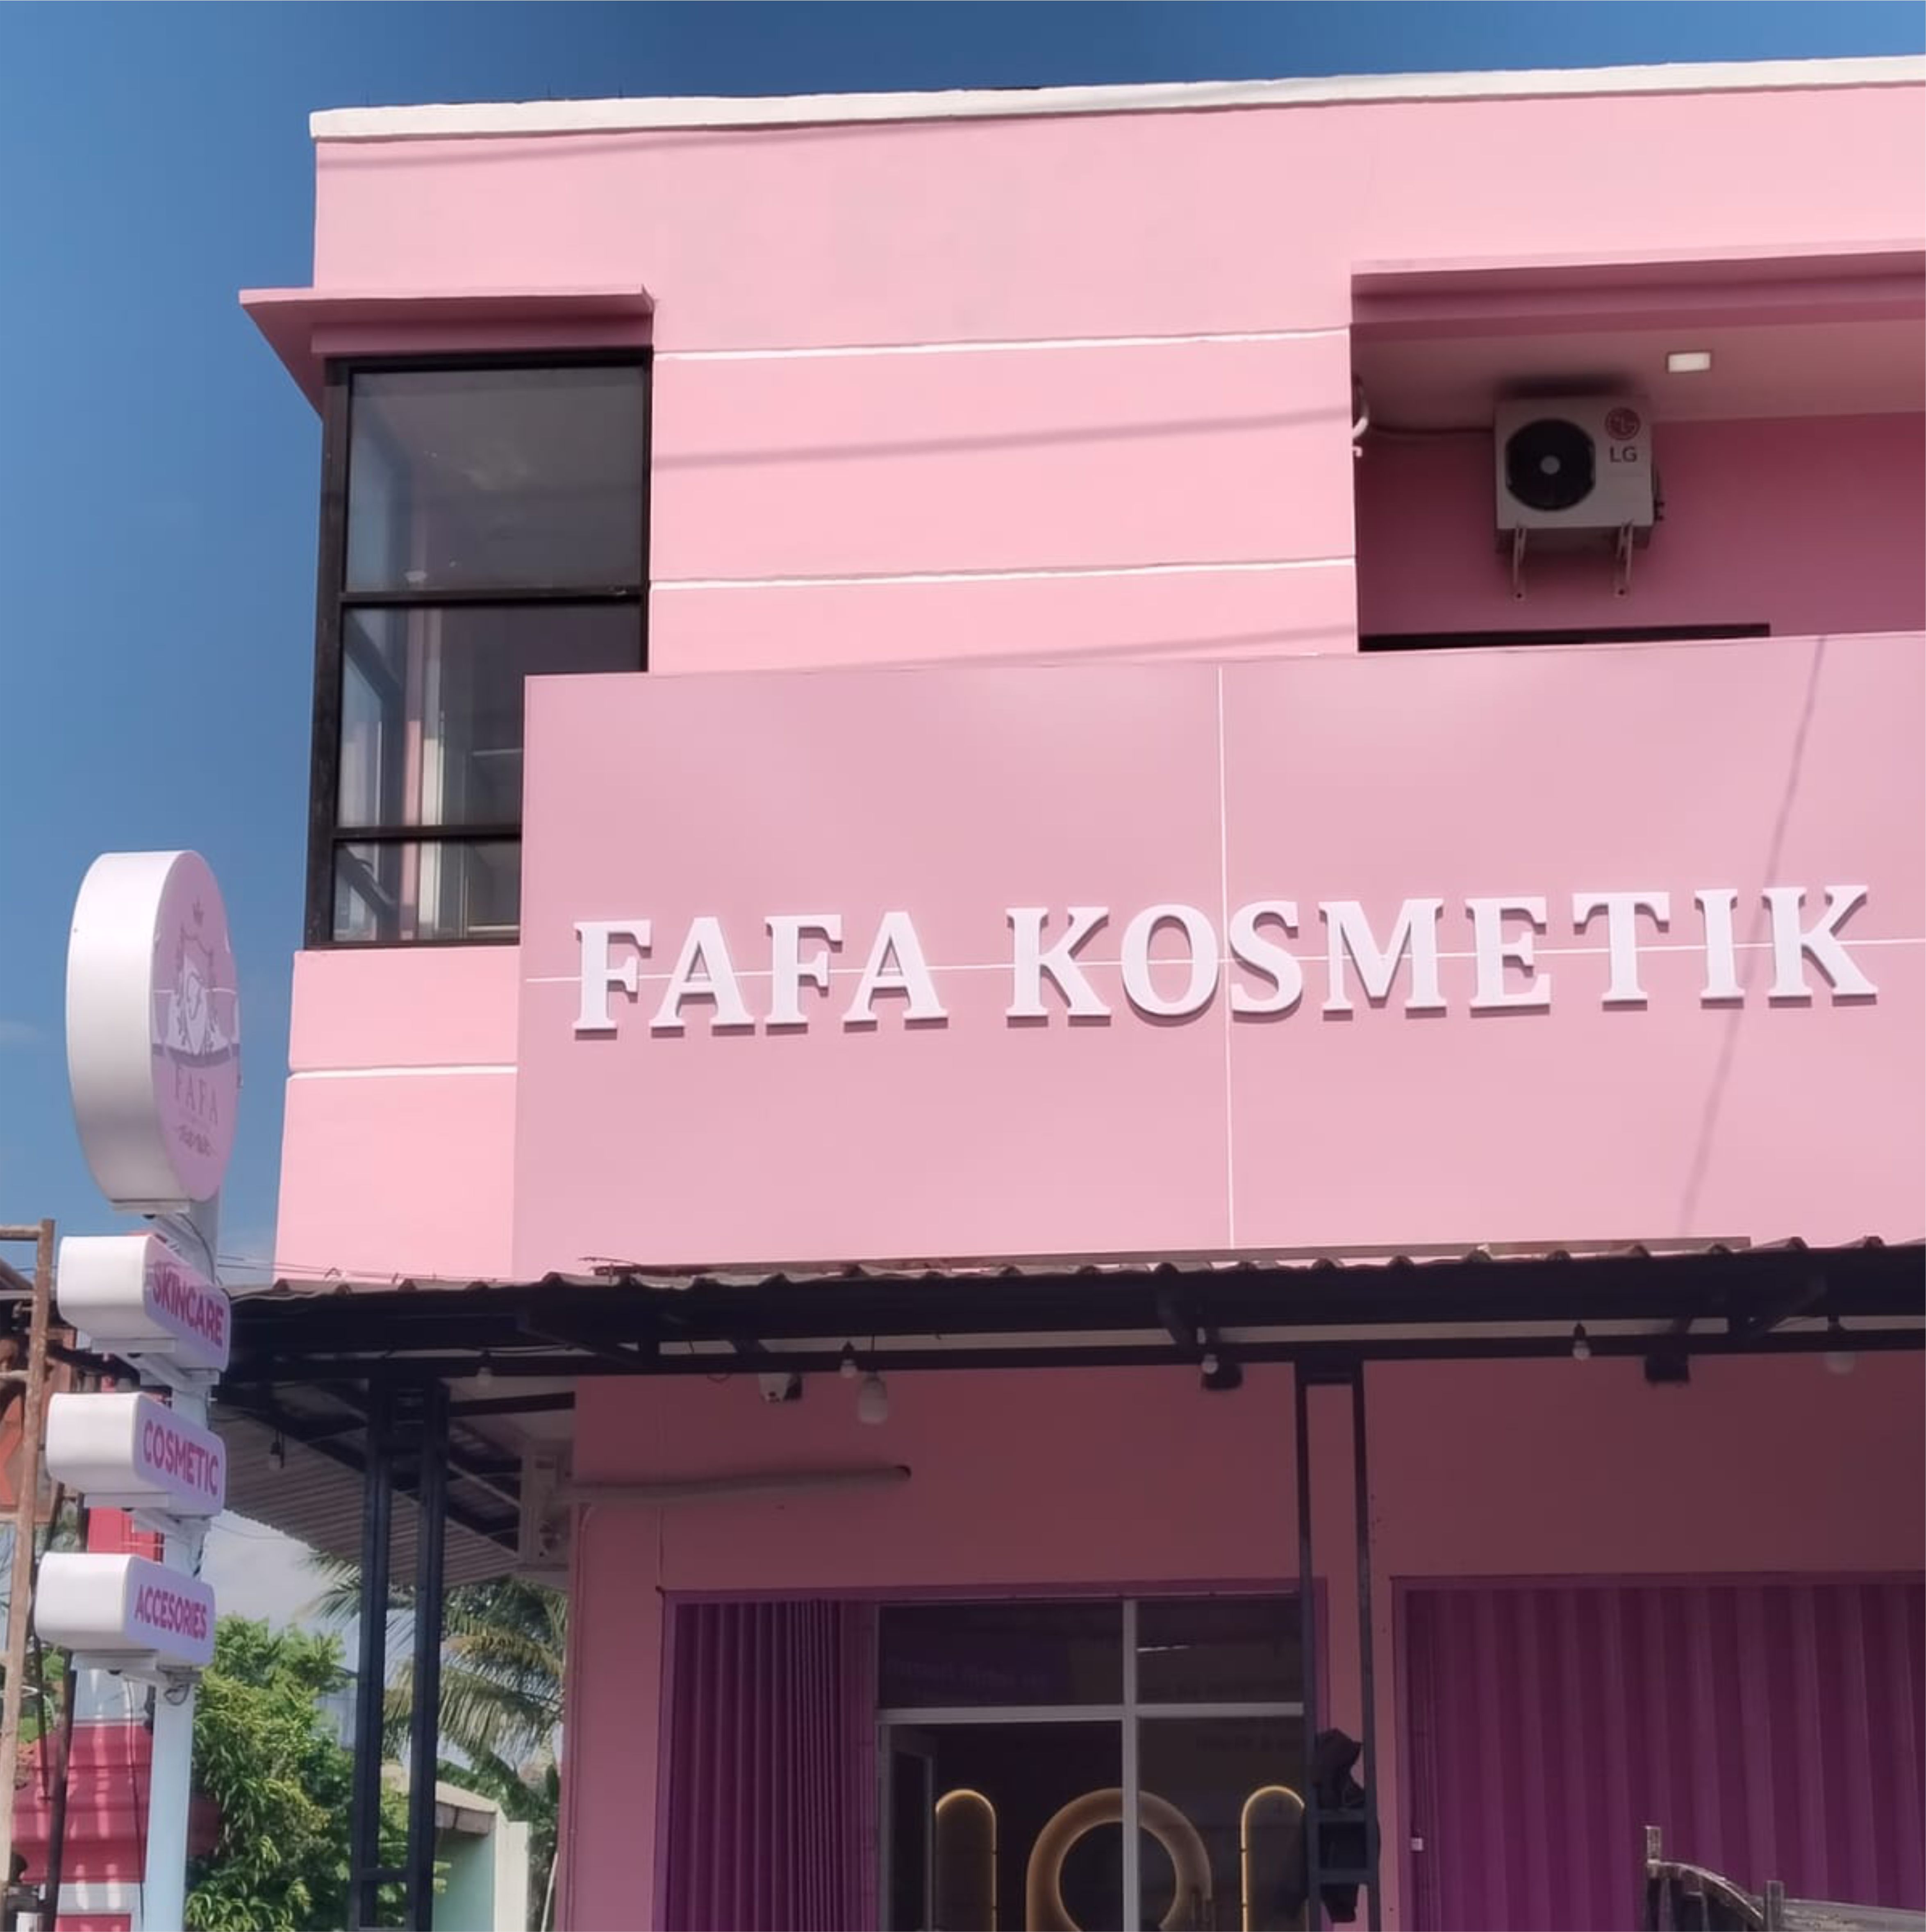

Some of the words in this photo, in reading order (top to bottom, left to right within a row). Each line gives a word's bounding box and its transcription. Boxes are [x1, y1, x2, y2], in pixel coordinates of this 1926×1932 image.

[1610, 446, 1637, 463] LG
[573, 911, 948, 1030] FAFA
[1005, 884, 1878, 1021] KOSMETIK
[173, 1064, 219, 1127] FAFA
[153, 1260, 224, 1348] SKINCARE
[143, 1418, 219, 1495] COSMETIC
[134, 1584, 207, 1641] ACCESORIES
